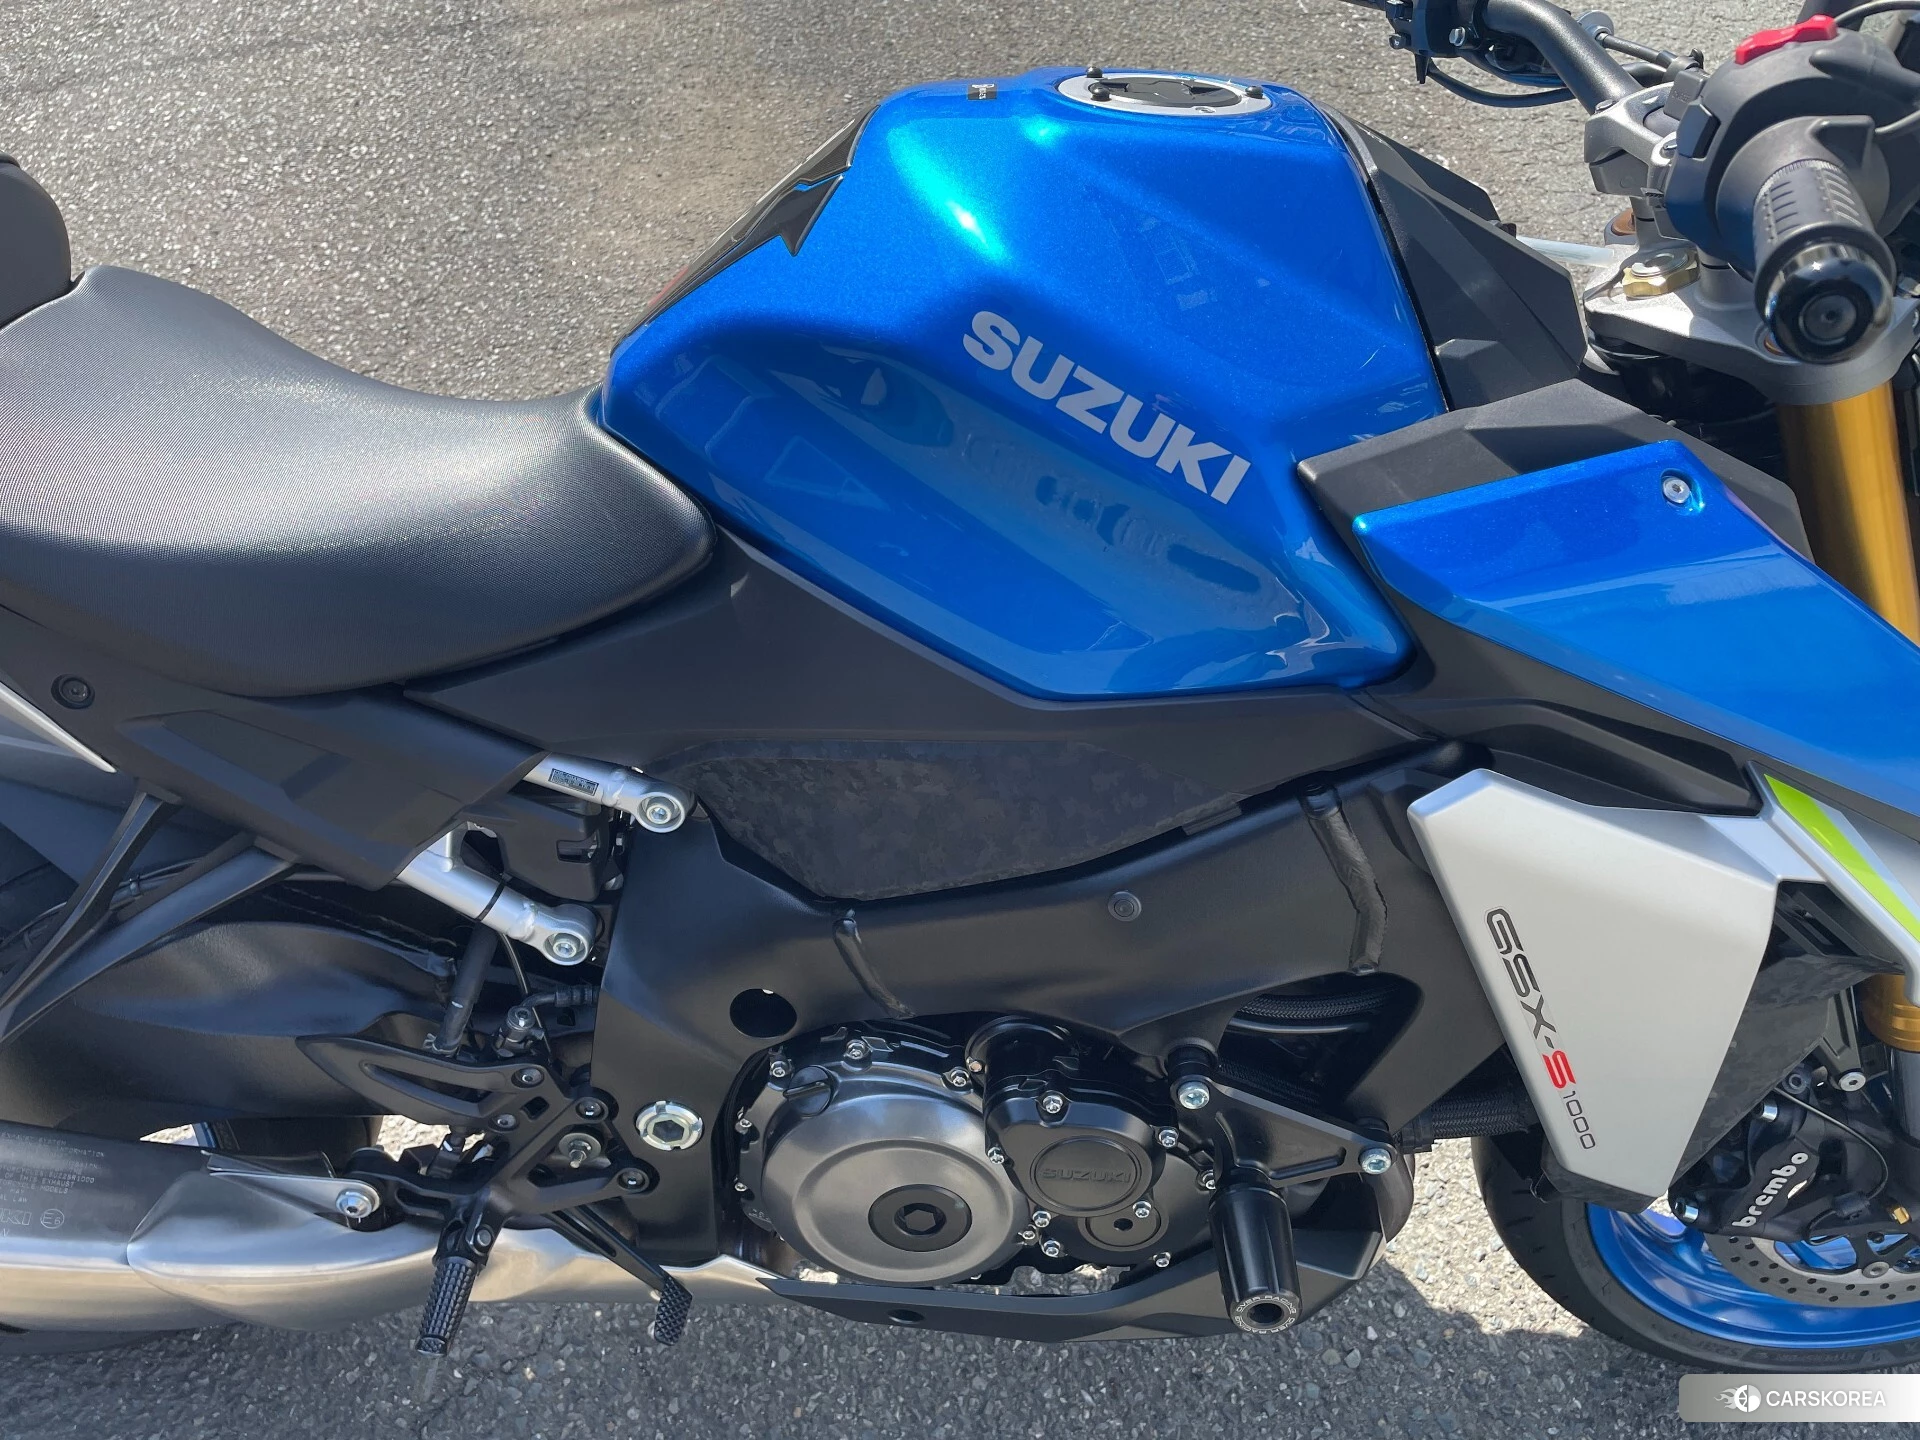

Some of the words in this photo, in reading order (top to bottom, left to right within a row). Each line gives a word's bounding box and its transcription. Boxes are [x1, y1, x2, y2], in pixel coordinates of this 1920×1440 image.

[963, 310, 1251, 505] SUZUKI
[1041, 1167, 1131, 1184] SUZUKI
[1732, 1151, 1809, 1228] brembo
[1236, 1296, 1261, 1312] OVER
